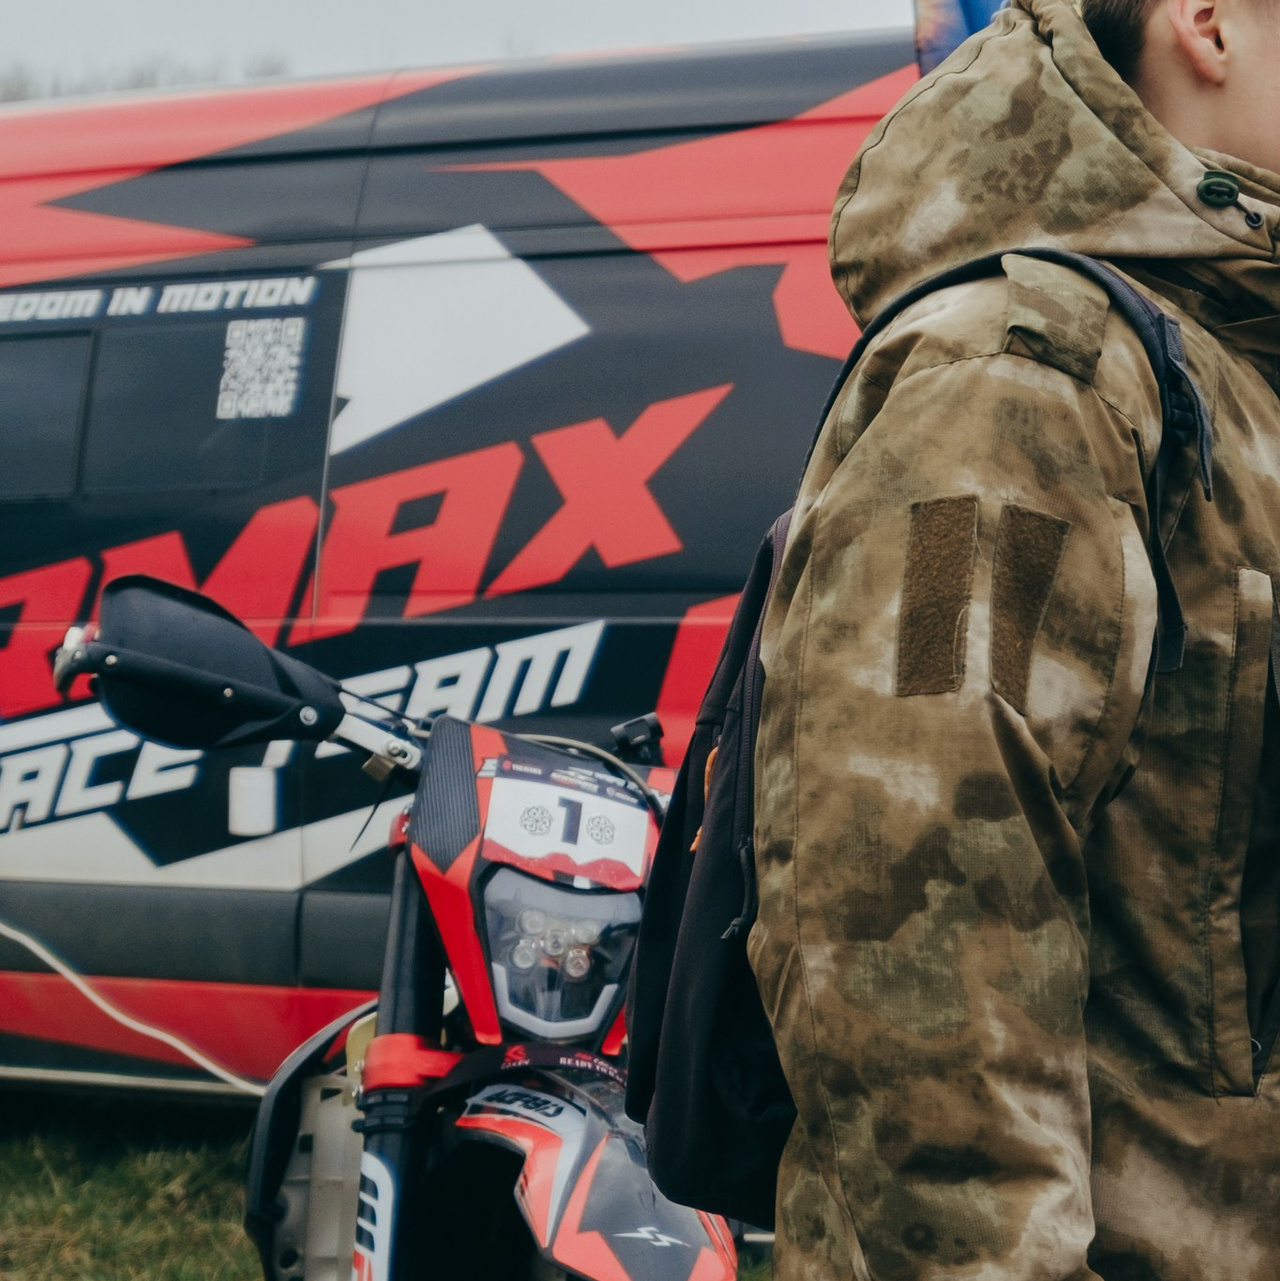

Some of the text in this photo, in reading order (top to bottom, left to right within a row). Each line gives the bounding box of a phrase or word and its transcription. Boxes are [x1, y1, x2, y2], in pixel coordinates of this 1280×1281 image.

[106, 285, 151, 316] IN
[156, 275, 317, 313] MOTION
[557, 796, 583, 845] 1
